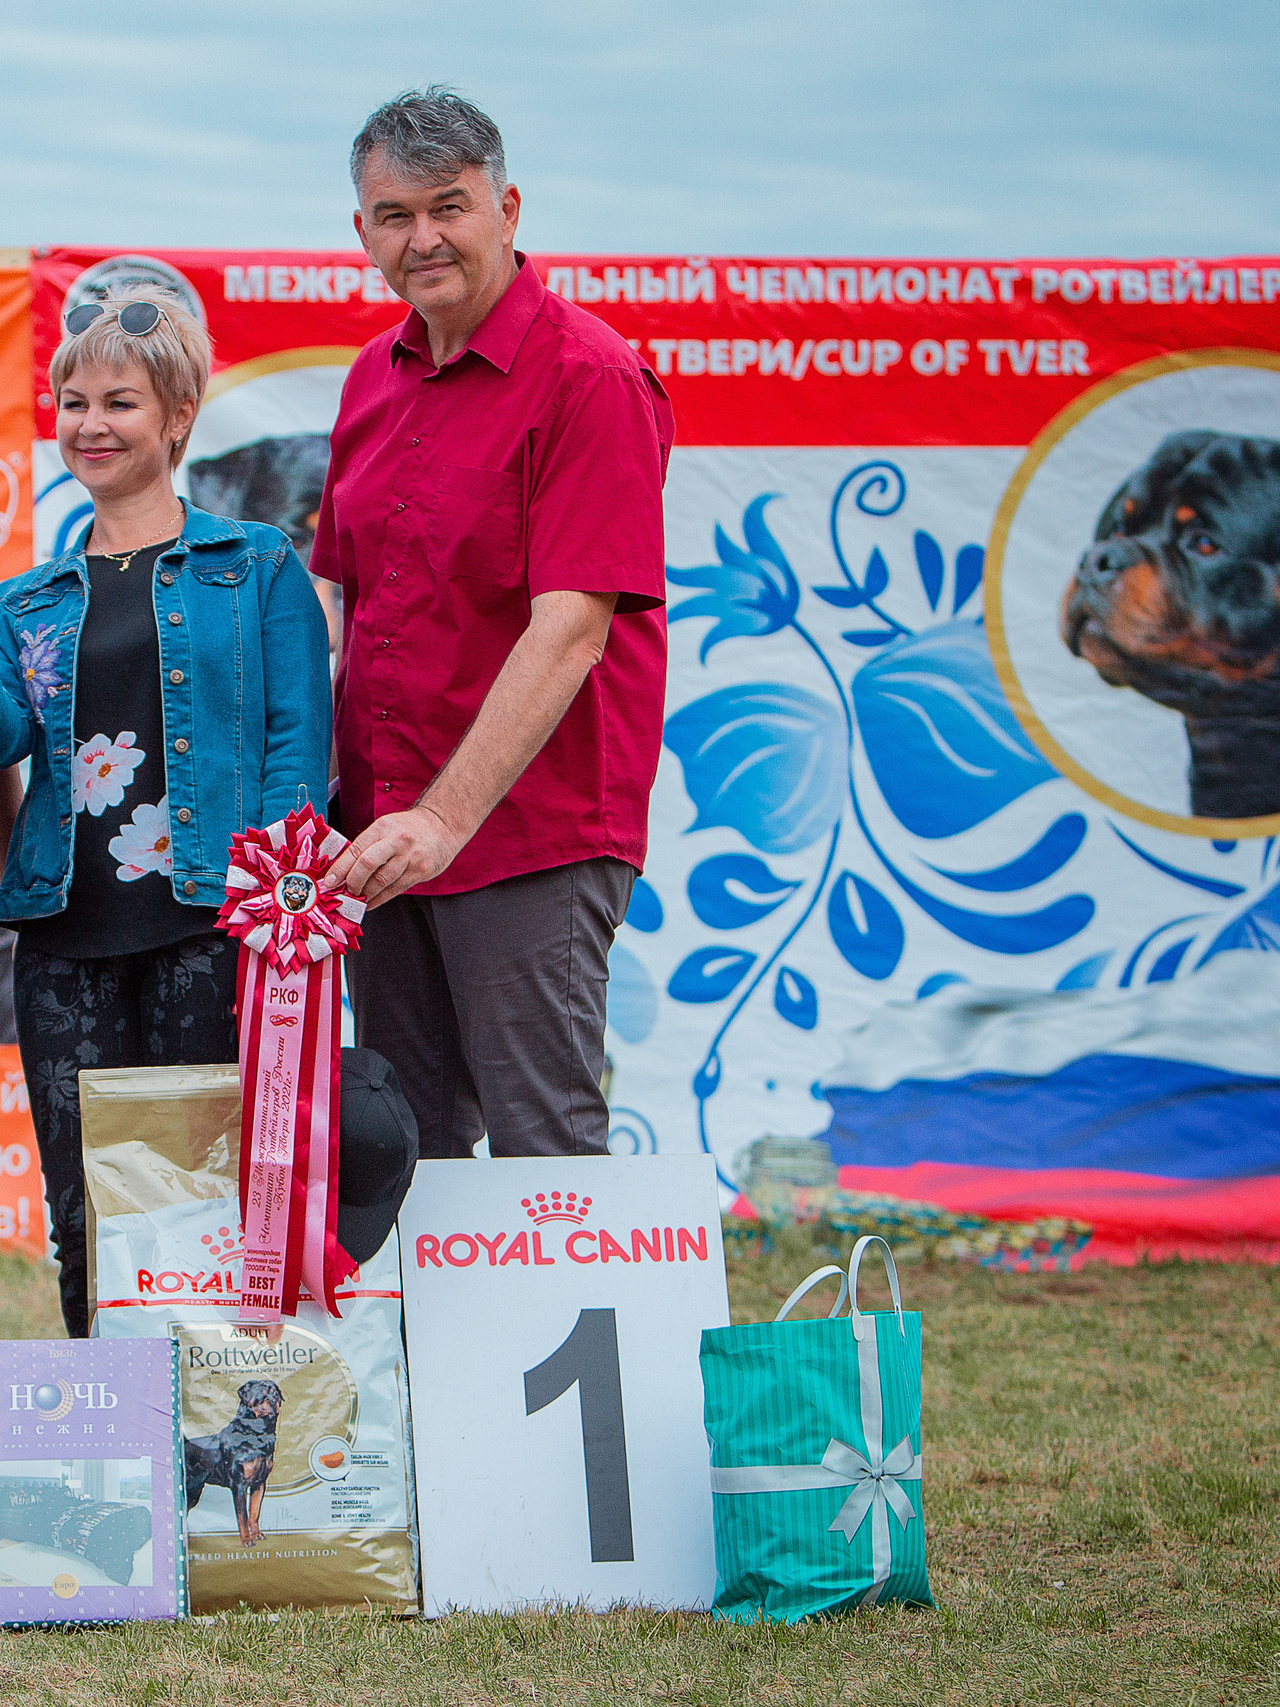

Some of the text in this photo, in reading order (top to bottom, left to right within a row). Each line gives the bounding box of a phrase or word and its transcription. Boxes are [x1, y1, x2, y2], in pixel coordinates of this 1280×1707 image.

[725, 265, 1020, 303] ЧЕМПИОНАТ
[647, 338, 1091, 381] ТВЕРИ/CUP OF TVER
[269, 986, 299, 1006] РКФ
[252, 1069, 271, 1208] 23 Межрегиональный
[258, 1035, 285, 1245] Чемпионат Ротвейлеров России
[277, 1118, 290, 1161] Твери
[415, 1226, 708, 1268] ROYAL CANIN
[137, 1268, 242, 1295] ROYAL
[249, 1276, 276, 1290] BEST
[241, 1293, 280, 1310] FEMALE
[230, 1328, 270, 1338] ADULT
[189, 1342, 318, 1368] Rottweiler
[523, 1307, 635, 1563] 1
[227, 1552, 270, 1560] HEALTH
[275, 1550, 338, 1558] NUTRITION
